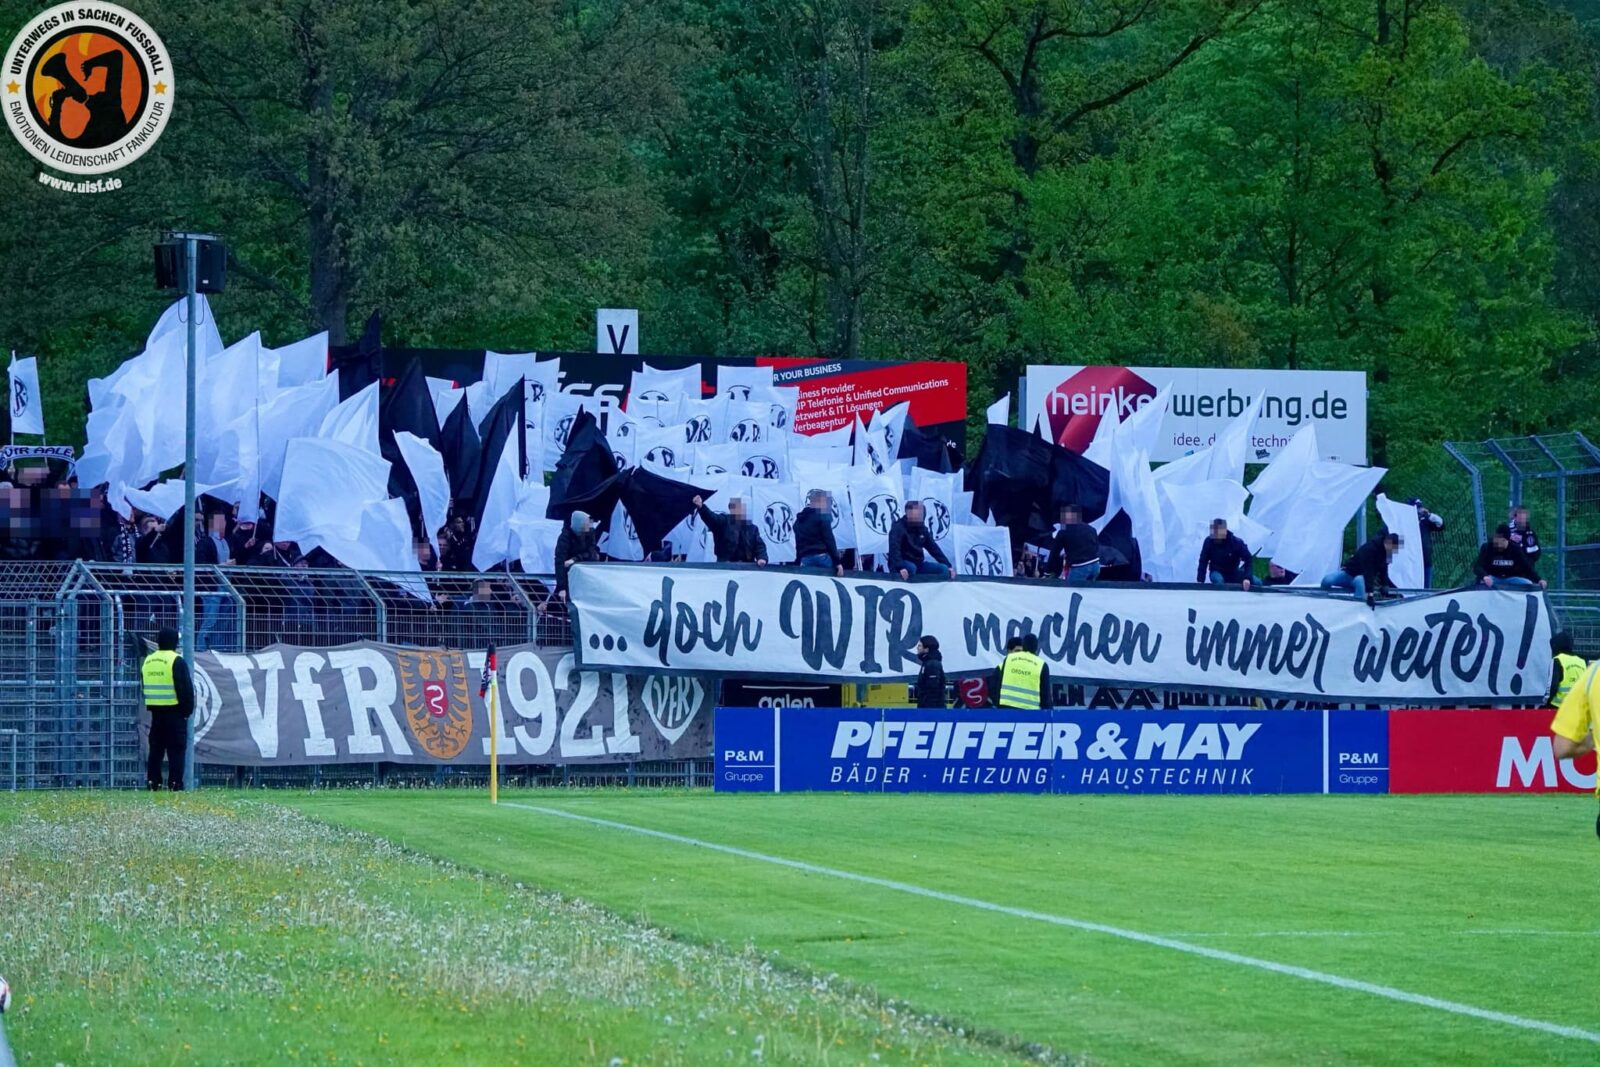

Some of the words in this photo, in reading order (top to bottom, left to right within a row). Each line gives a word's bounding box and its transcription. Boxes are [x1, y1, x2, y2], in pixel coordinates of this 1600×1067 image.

[606, 324, 630, 355] V
[773, 373, 780, 382] R
[780, 367, 803, 380] YOUR
[804, 363, 842, 377] BUSINESS
[797, 389, 820, 399] iness
[821, 383, 856, 395] Provider
[807, 396, 844, 408] Telefonie
[845, 393, 852, 402] &
[853, 389, 882, 401] Unified
[882, 378, 949, 398] Communications
[1050, 386, 1157, 416] heinke
[795, 409, 828, 421] etzwerk
[828, 406, 836, 416] &
[836, 405, 846, 415] IT
[1173, 434, 1205, 446] idee.
[34, 446, 73, 457] AALE
[643, 575, 763, 667] doch
[779, 578, 932, 673] WIR
[963, 592, 1162, 666] machen
[1186, 608, 1331, 692] immer
[1353, 594, 1539, 695] weiter!
[211, 648, 414, 758] VfR
[467, 650, 641, 758] 1921
[830, 721, 1082, 760] PFEIFFER
[1086, 722, 1129, 760] &
[1134, 723, 1262, 760] MAY
[724, 750, 764, 762] P&M
[1339, 753, 1379, 764] P&M
[724, 771, 764, 783] Gruppe
[830, 763, 911, 784] BÄDER
[942, 767, 1048, 784] HEIZUNG
[1080, 768, 1254, 785] HAUSTECHNIK
[1339, 774, 1378, 785] Gruppe
